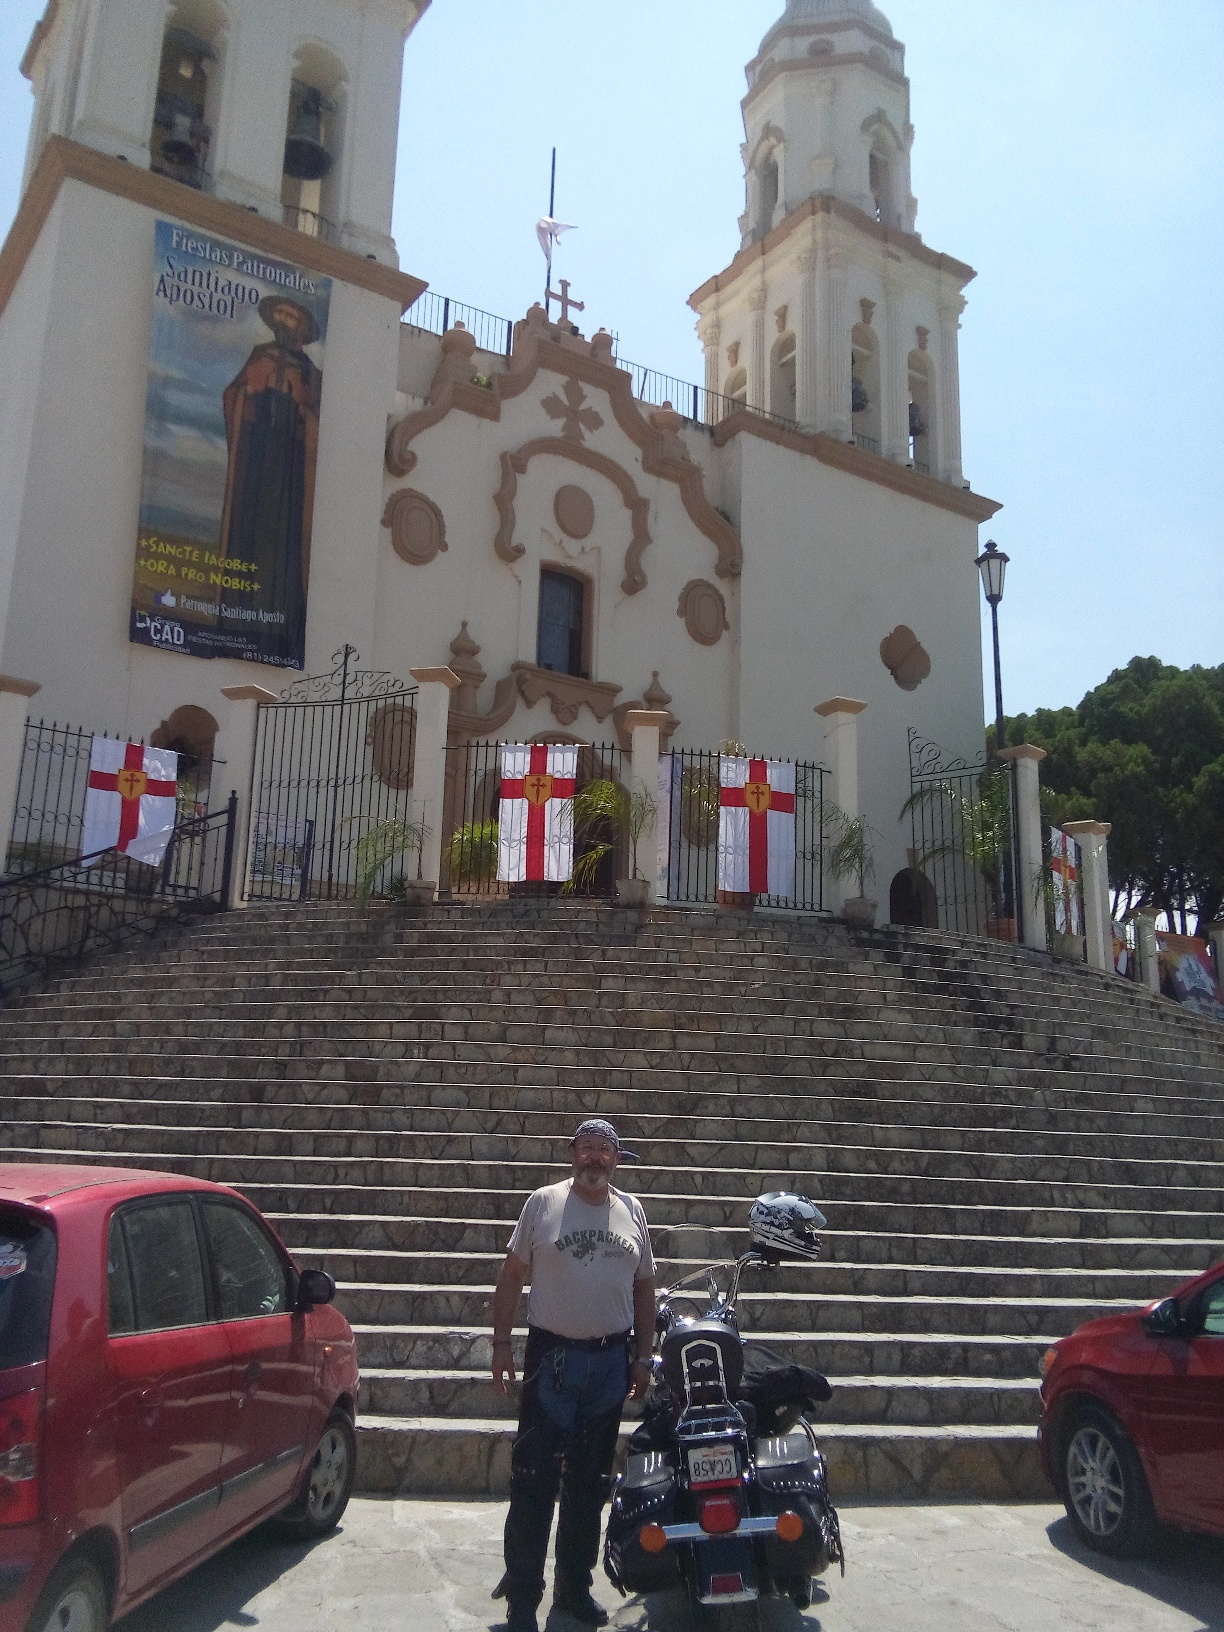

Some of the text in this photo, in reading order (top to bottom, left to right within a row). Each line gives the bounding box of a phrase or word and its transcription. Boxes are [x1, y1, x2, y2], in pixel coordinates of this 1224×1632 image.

[171, 230, 316, 294] Fiestas Patronales
[165, 255, 259, 305] Santiago
[155, 274, 235, 318] Apostol
[181, 567, 205, 583] PRO
[180, 595, 219, 616] Parroquia
[220, 603, 257, 622] Santiago
[151, 622, 185, 645] CAD
[554, 1229, 635, 1254] BACKPACKER
